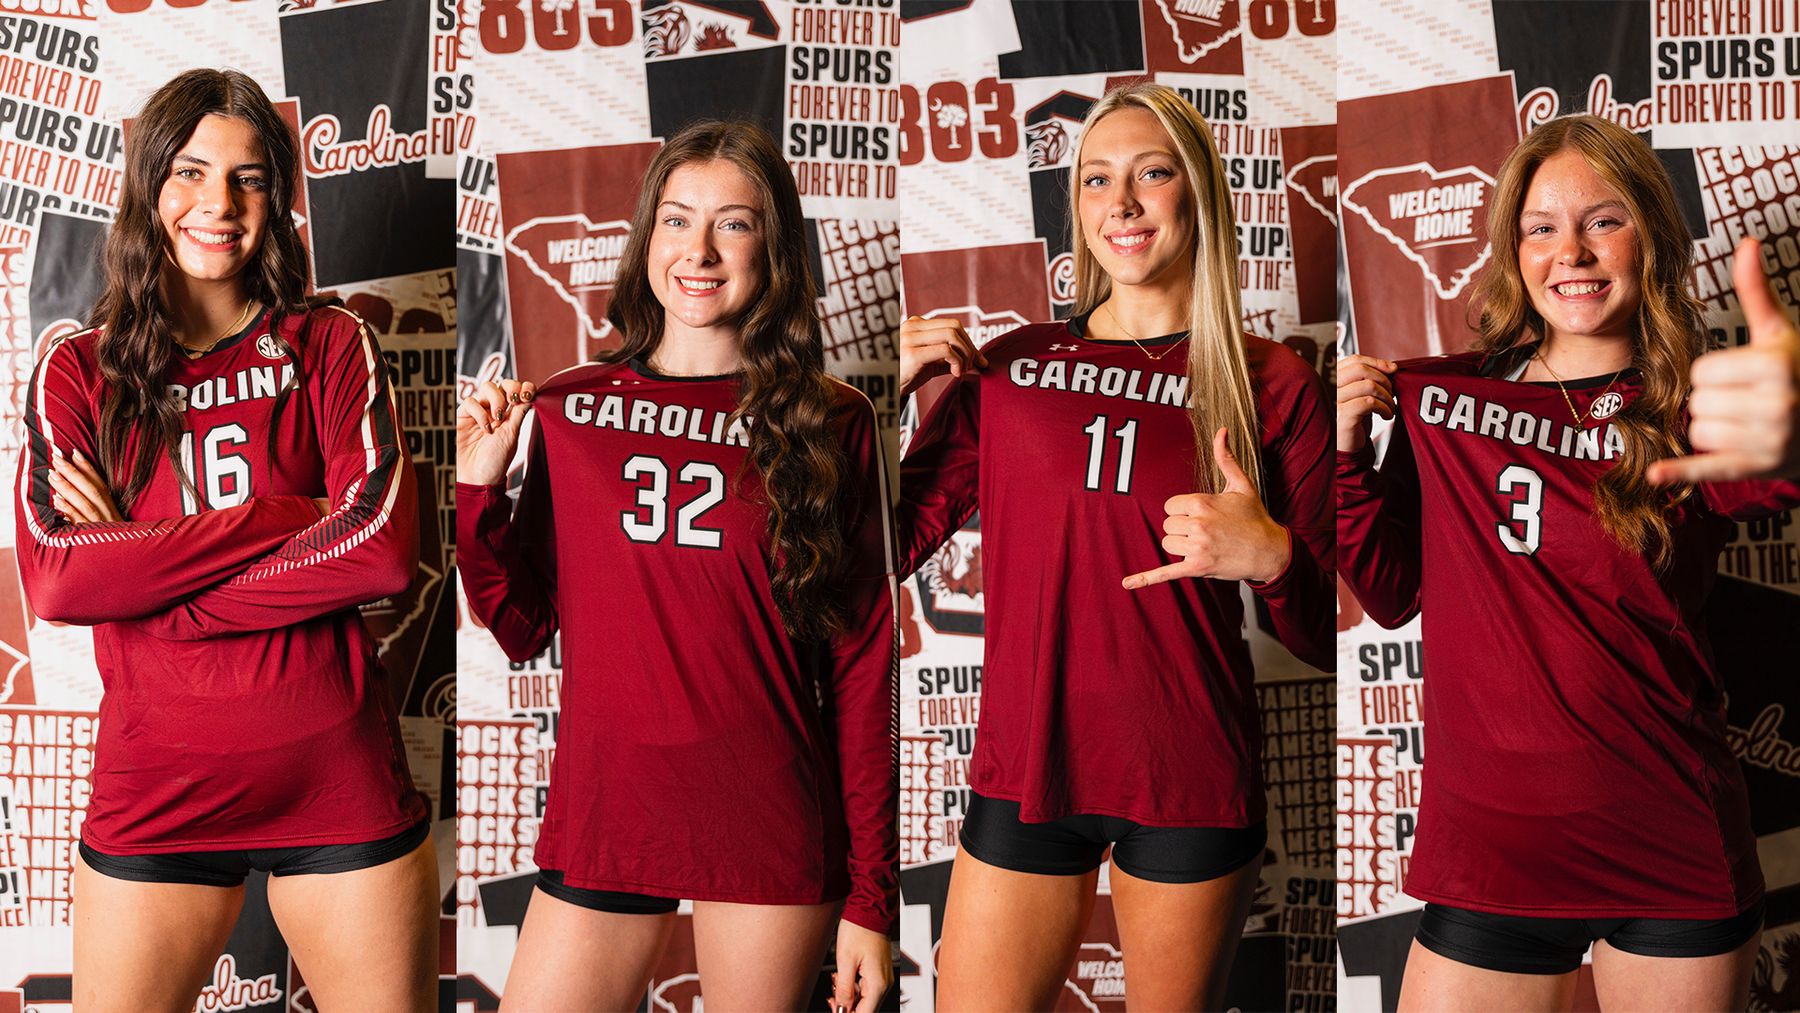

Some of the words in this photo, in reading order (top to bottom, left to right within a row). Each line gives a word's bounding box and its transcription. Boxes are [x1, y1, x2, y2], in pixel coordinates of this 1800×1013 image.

[480, 0, 634, 54] 803
[792, 8, 874, 45] FOREVER
[1656, 0, 1751, 38] FOREVER
[0, 16, 100, 73] SPURS
[792, 46, 892, 84] SPURS
[1657, 38, 1775, 80] SPURS
[73, 75, 102, 116] TO
[789, 84, 871, 122] FOREVER
[877, 88, 899, 123] TO
[1656, 82, 1752, 124] FOREVER
[1758, 81, 1785, 121] TO
[302, 107, 428, 175] Carolina
[790, 123, 889, 160] SPURS
[53, 155, 81, 195] TO
[875, 165, 896, 199] TO
[1257, 193, 1286, 224] THE
[1389, 181, 1485, 219] WELCOME
[1414, 209, 1474, 242] HOME
[1008, 357, 1194, 409] CAROLIN
[563, 391, 756, 448] CAROLIN
[1419, 384, 1626, 462] CAROLINA
[1592, 393, 1622, 418] SEC
[179, 420, 252, 516] 16
[1082, 413, 1140, 496] 11
[620, 453, 727, 551] 32
[1495, 462, 1546, 558] 3
[1755, 543, 1798, 585] THE
[0, 745, 94, 777] GAMEC
